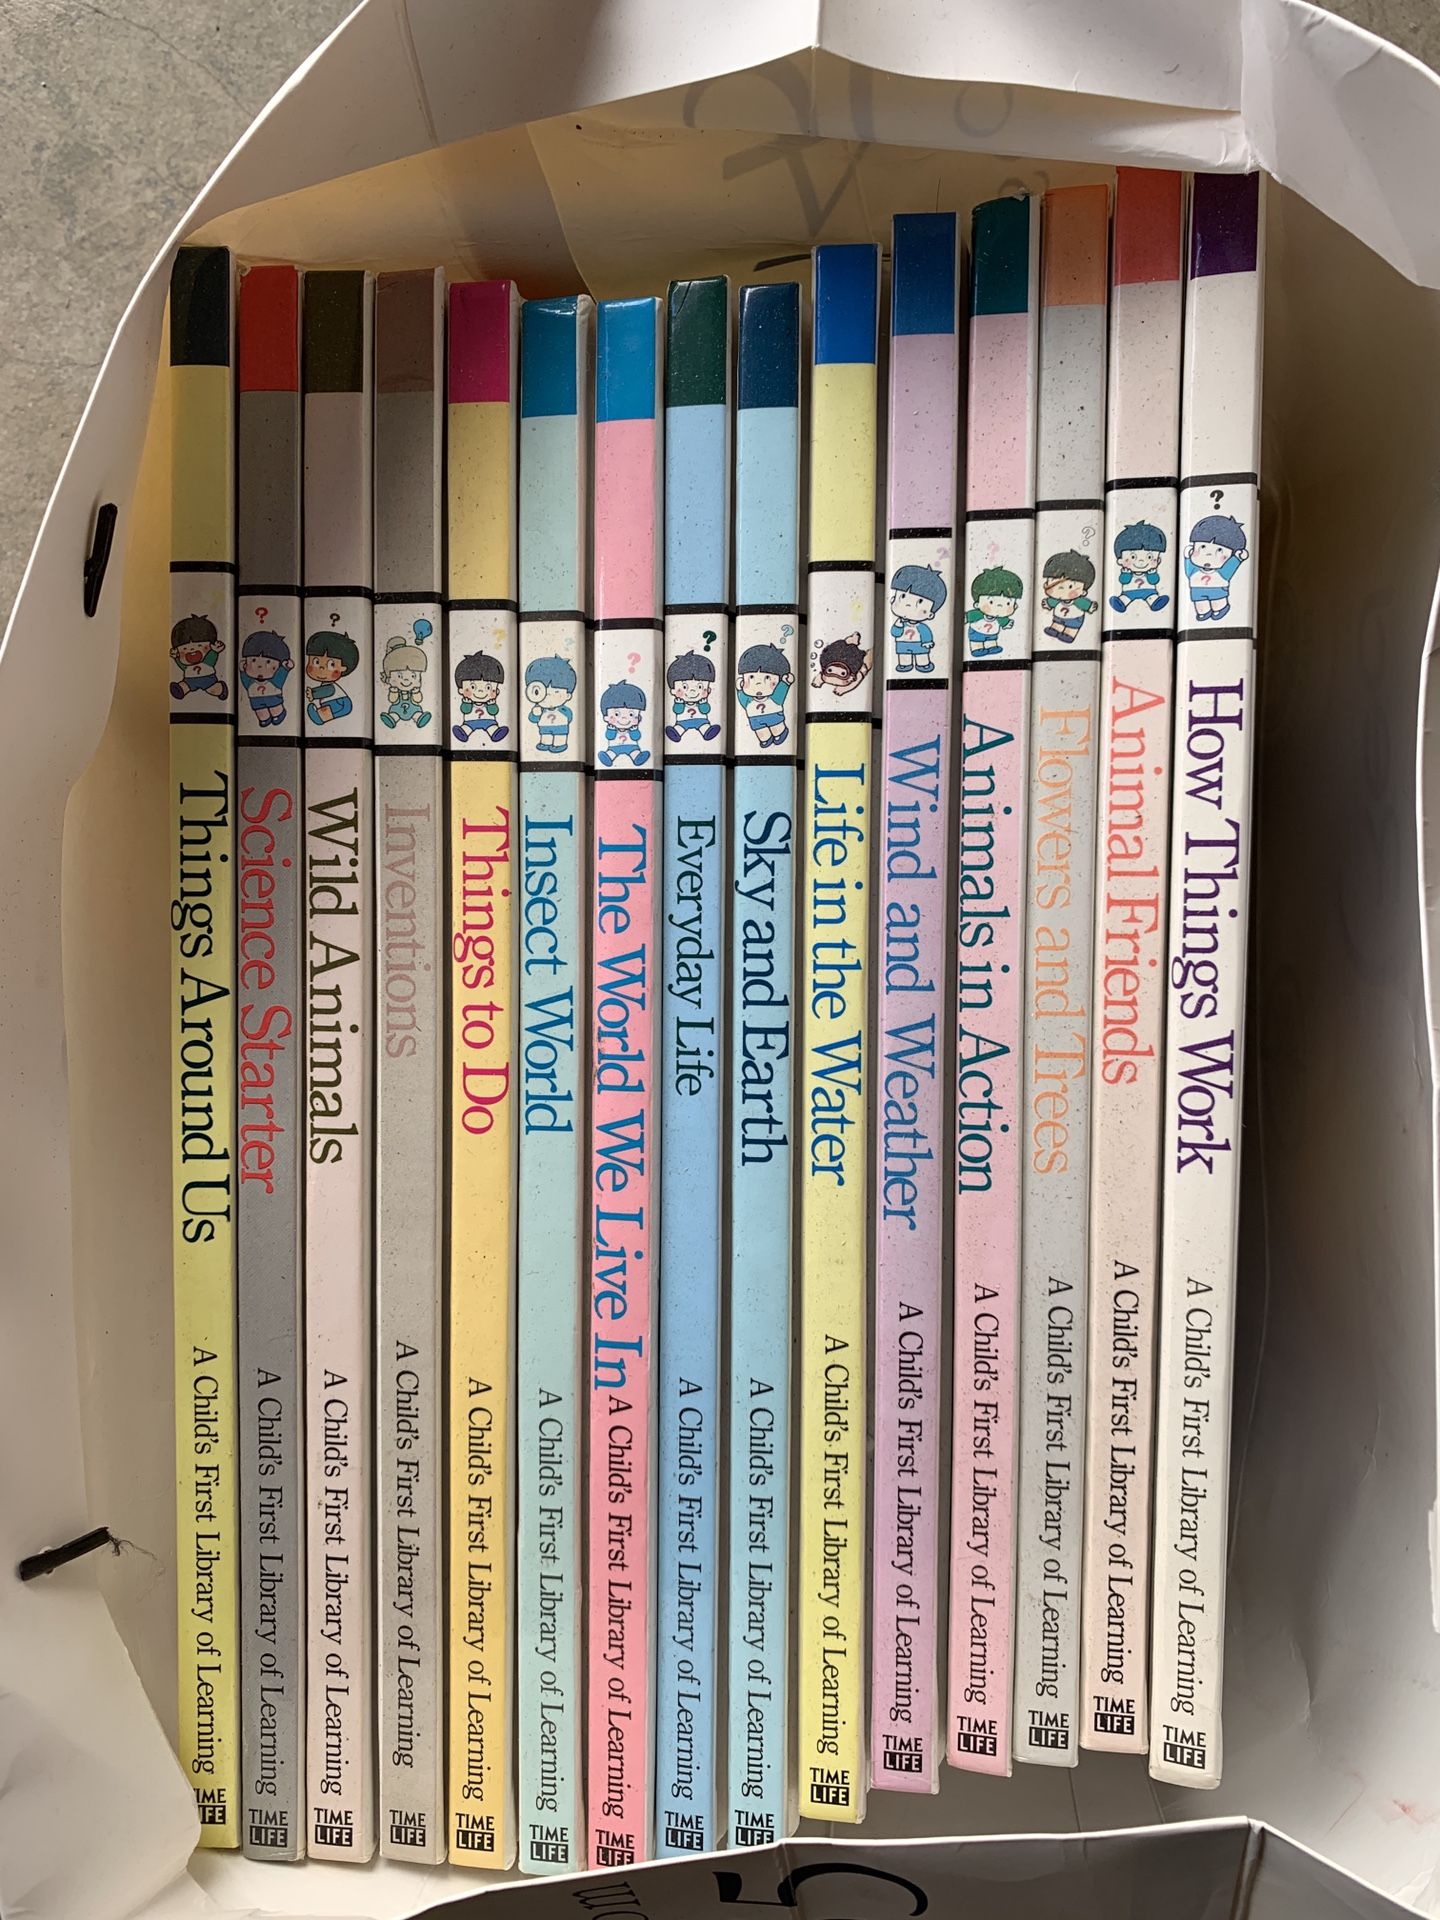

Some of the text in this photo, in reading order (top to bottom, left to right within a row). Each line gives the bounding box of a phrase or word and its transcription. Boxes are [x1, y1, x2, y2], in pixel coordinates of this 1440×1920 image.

[171, 770, 231, 1244] Things Around Us
[240, 788, 292, 1194] Science Starter
[307, 787, 360, 1165] Wild Animals
[384, 803, 431, 1059] Inventions
[453, 806, 510, 1135] Things to Do
[524, 815, 573, 1135] Insect World
[668, 815, 716, 1096] Everyday Life
[735, 810, 792, 1166] Sky and Earth
[811, 763, 864, 1186] Life in the Water
[883, 734, 940, 1230] Wind and Weather
[957, 714, 1014, 1195] Animals in Action
[1031, 707, 1090, 1175] Flowers and Trees
[1102, 675, 1165, 1085] Animal Friends
[1171, 678, 1244, 1174] How Things Work
[594, 823, 647, 1390] The World We Live In
[191, 1346, 221, 1774] A Child's First Library of Learning
[255, 1368, 284, 1796] A Child's First Library of Learning
[321, 1369, 349, 1795] A Child's First Library of Learning
[393, 1340, 420, 1768] A Child's First Library of Learning
[462, 1377, 492, 1801] A Child's First Library of Learning
[535, 1388, 564, 1812] A Child's First Library of Learning
[602, 1395, 632, 1819] A Child's First Library of Learning
[672, 1377, 703, 1800] A Child's First Library of Learning
[742, 1378, 774, 1799] A Child's First Library of Learning
[817, 1334, 849, 1755] A Child's First Library of Learning
[890, 1301, 923, 1723] A Child's First Library of Learning
[964, 1283, 999, 1705] A Child's First Library of Learning
[1036, 1276, 1073, 1698] A Child's First Library of Learning
[1101, 1260, 1139, 1684] A Child's First Library of Learning
[1171, 1277, 1213, 1716] A Child's First Library of Learning
[313, 1807, 353, 1825] TIME
[455, 1812, 495, 1831] TIME
[456, 1829, 494, 1852] LIFE
[529, 1824, 569, 1842] TIME
[595, 1829, 635, 1849] TIME
[664, 1810, 704, 1831] TIME
[735, 1809, 774, 1829] TIME
[809, 1768, 850, 1787] TIME
[810, 1784, 849, 1807] LIFE
[882, 1734, 923, 1754] TIME
[884, 1751, 922, 1773] LIFE
[957, 1716, 998, 1735] TIME
[957, 1732, 997, 1756] LIFE
[1028, 1710, 1069, 1728] TIME
[1029, 1726, 1068, 1749] LIFE
[1093, 1695, 1135, 1714] TIME
[1094, 1712, 1134, 1735] LIFE
[1163, 1725, 1206, 1747] TIME
[1164, 1742, 1206, 1769] LIFE
